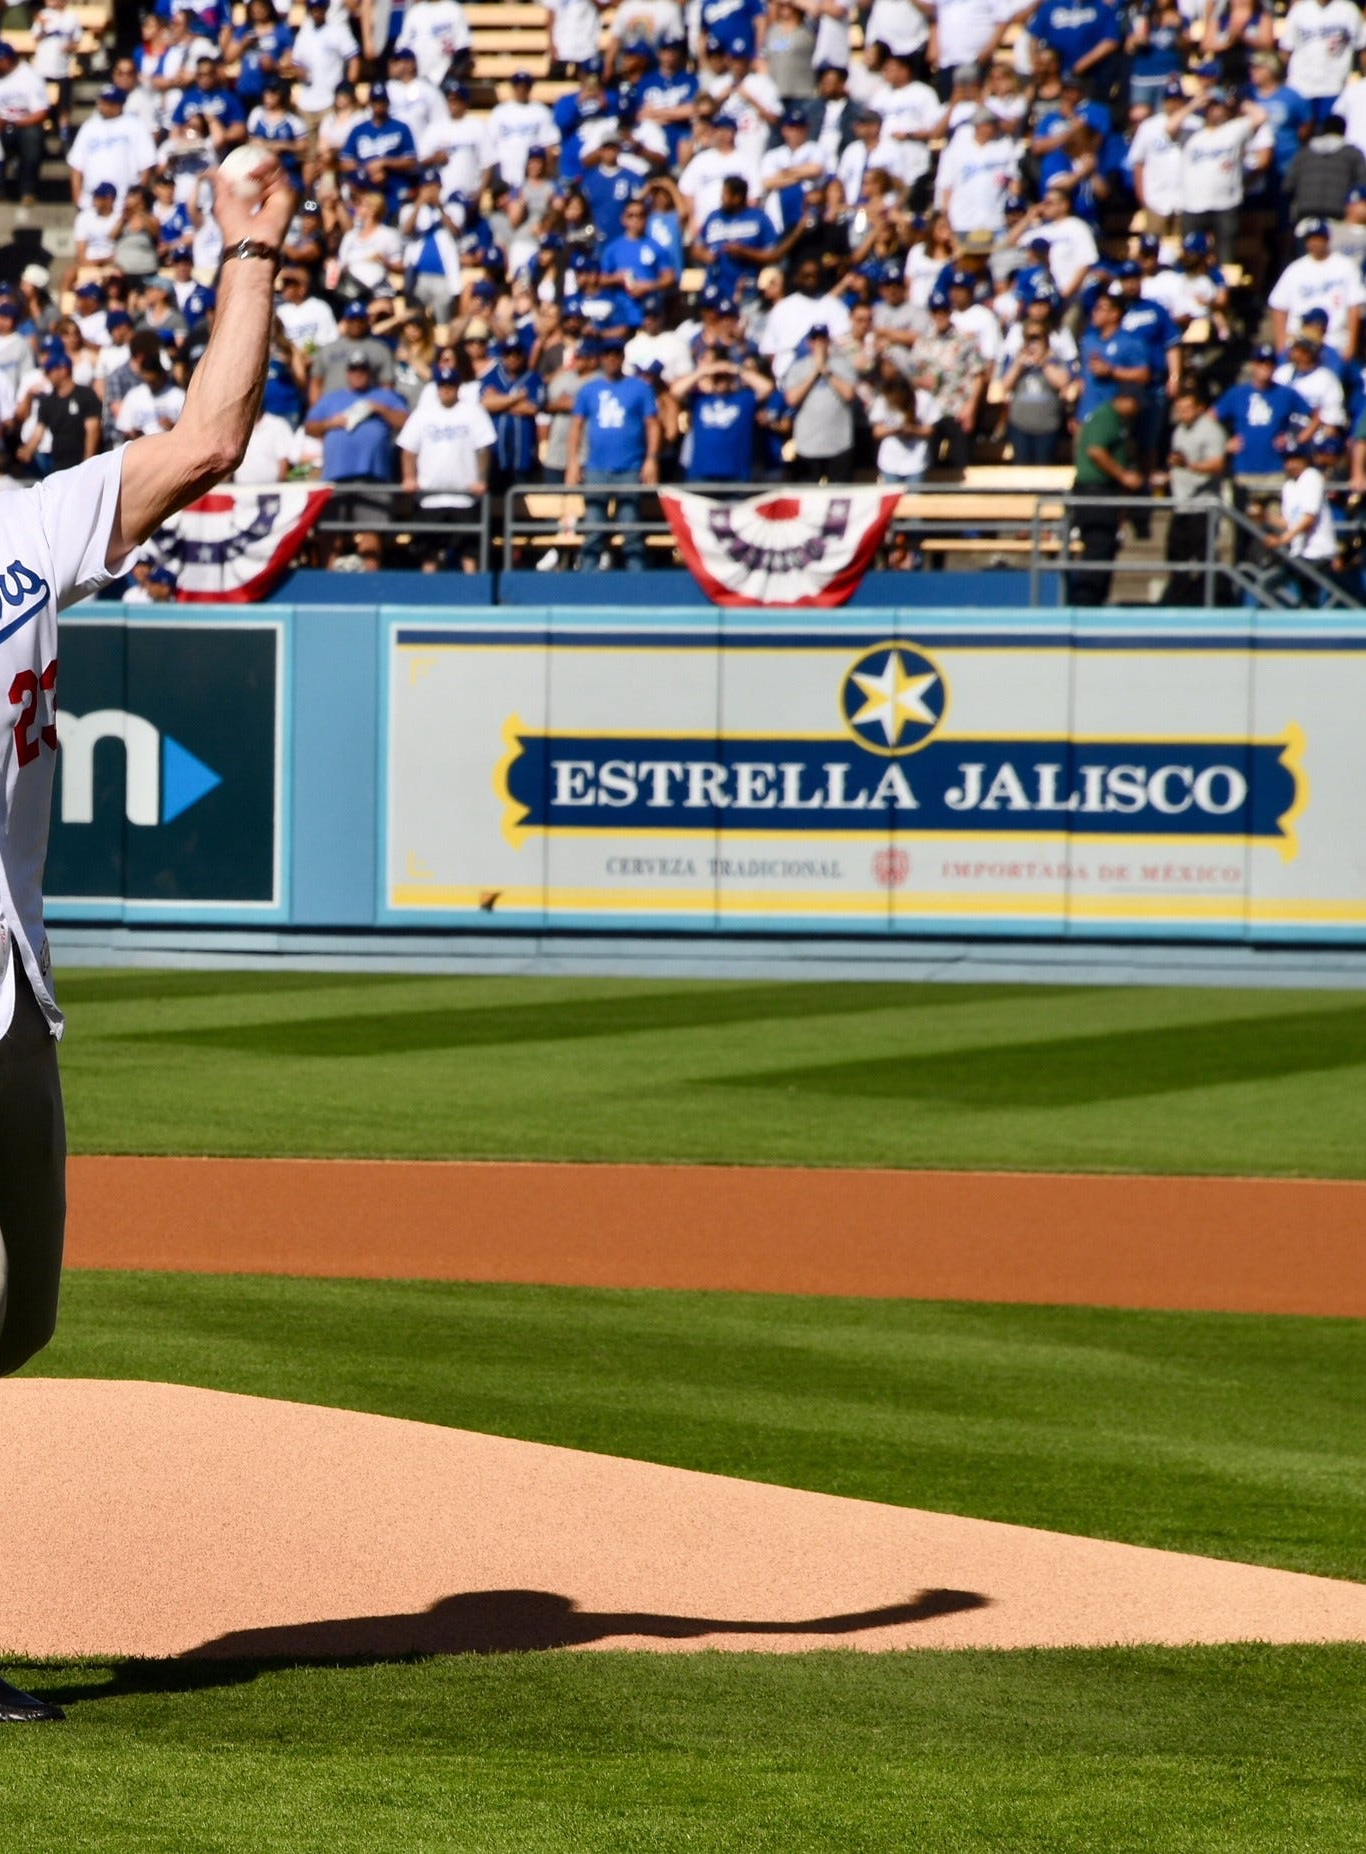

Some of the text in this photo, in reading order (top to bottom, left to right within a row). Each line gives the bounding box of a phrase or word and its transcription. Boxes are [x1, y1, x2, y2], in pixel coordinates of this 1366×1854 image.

[551, 760, 1248, 815] ESTRELLA JALISCO
[605, 856, 843, 880] CERVEZA TRADICIONAL
[941, 861, 1090, 881] IMPORTADA
[1099, 865, 1129, 882] DE
